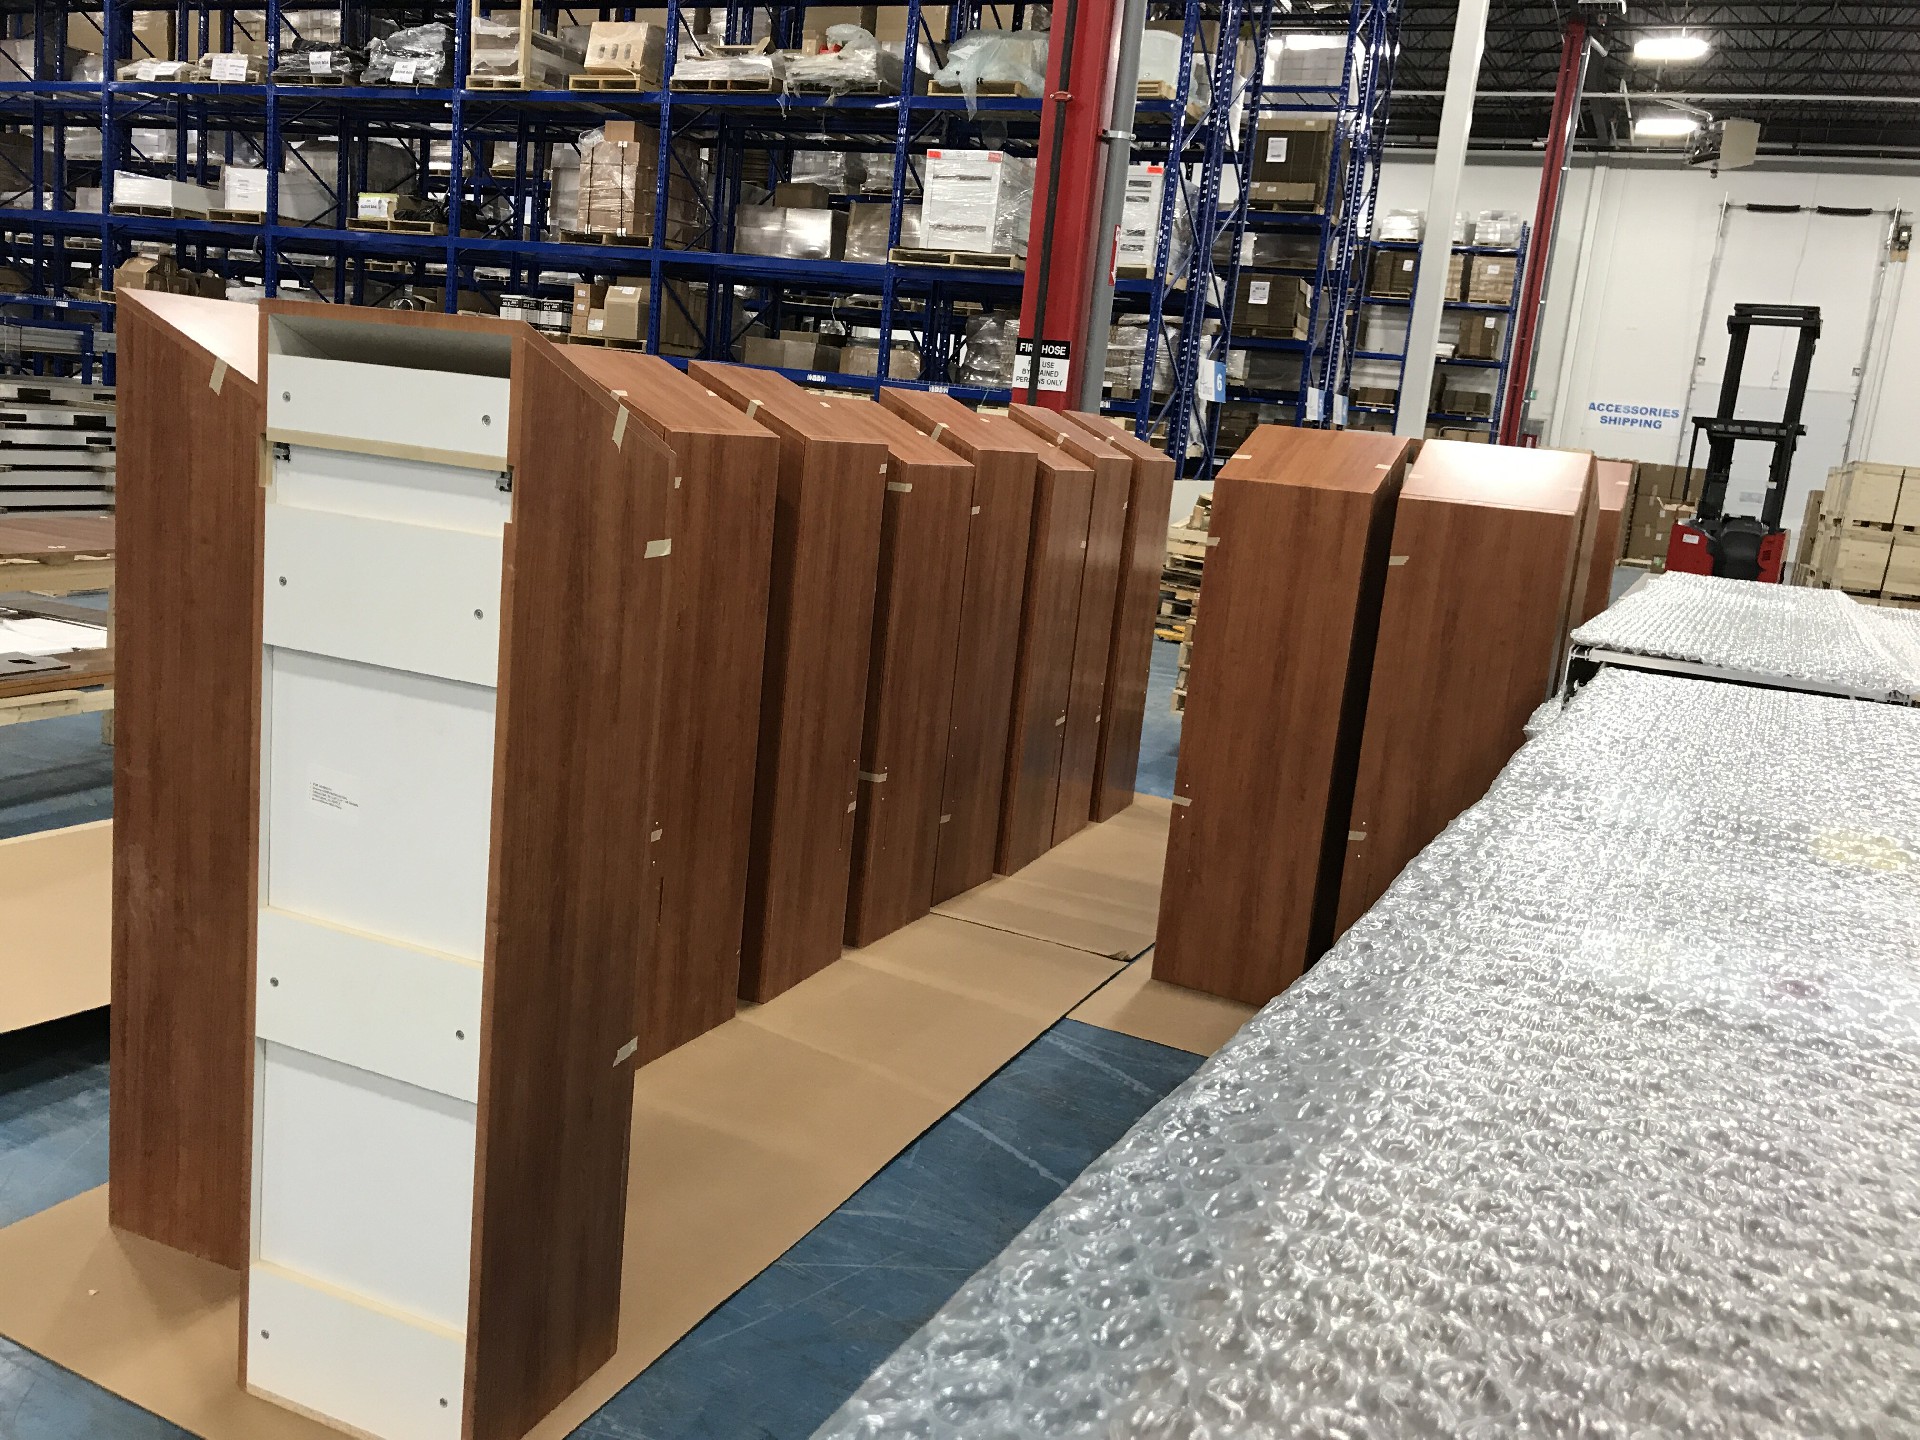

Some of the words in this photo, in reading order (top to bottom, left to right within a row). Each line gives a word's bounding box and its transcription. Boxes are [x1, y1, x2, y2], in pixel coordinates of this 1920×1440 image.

[1041, 344, 1067, 356] HOSE
[1041, 361, 1055, 369] USE
[1216, 373, 1223, 392] 6
[1588, 402, 1680, 419] ACCESSORIES
[1599, 415, 1663, 430] SHIPPING
